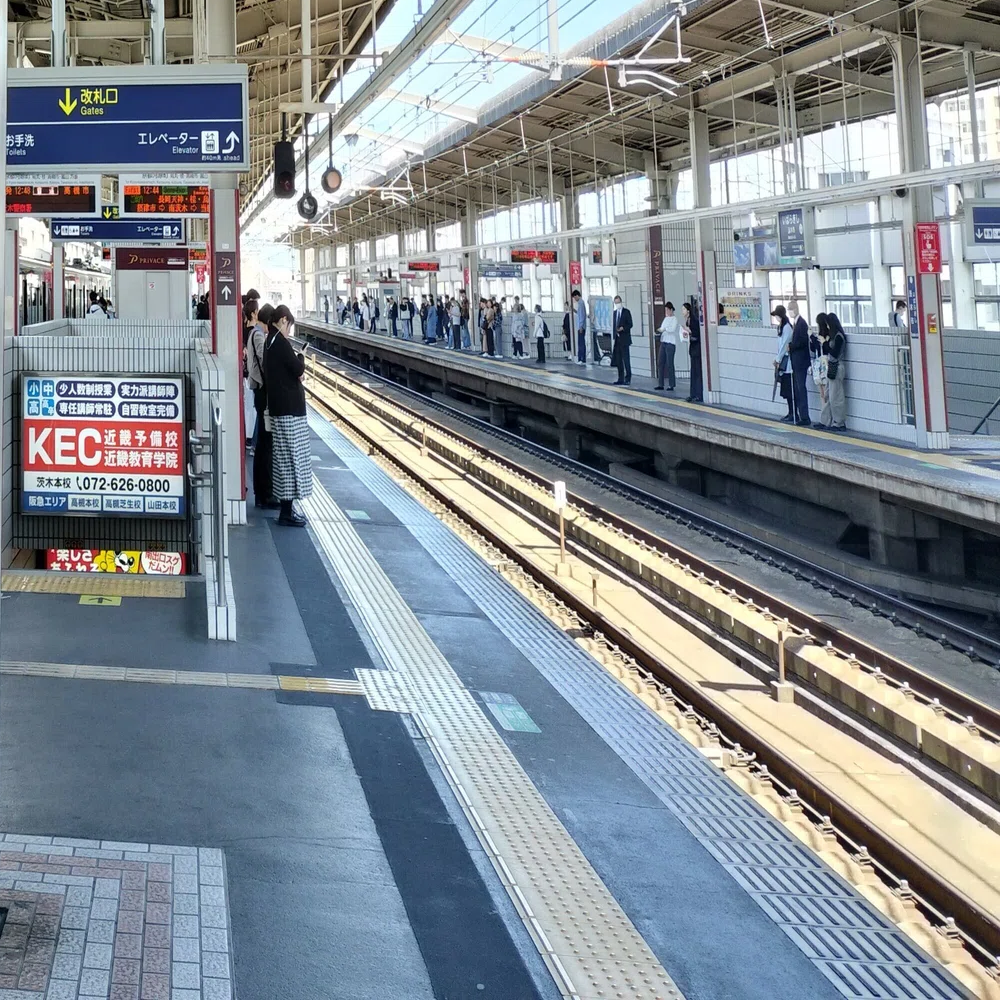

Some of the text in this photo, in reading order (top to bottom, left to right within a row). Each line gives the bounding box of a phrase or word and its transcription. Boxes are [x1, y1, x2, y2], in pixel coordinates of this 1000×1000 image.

[80, 88, 118, 104] 改札口
[80, 106, 104, 116] Gates
[6, 133, 35, 147] お手洗
[137, 131, 199, 146] エレベーター
[172, 146, 199, 154] Elevator
[29, 382, 53, 396] 小 中
[29, 401, 39, 414] 高
[122, 403, 175, 417] 自習教室完備
[104, 429, 178, 447] 近畿予備校
[29, 427, 102, 467] KEC
[104, 450, 178, 468] 近畿教育学院
[36, 476, 71, 489] 茨木本校
[28, 496, 67, 507] 阪急エリア
[71, 497, 100, 508] 高槻本校
[148, 501, 176, 511] 山田本校
